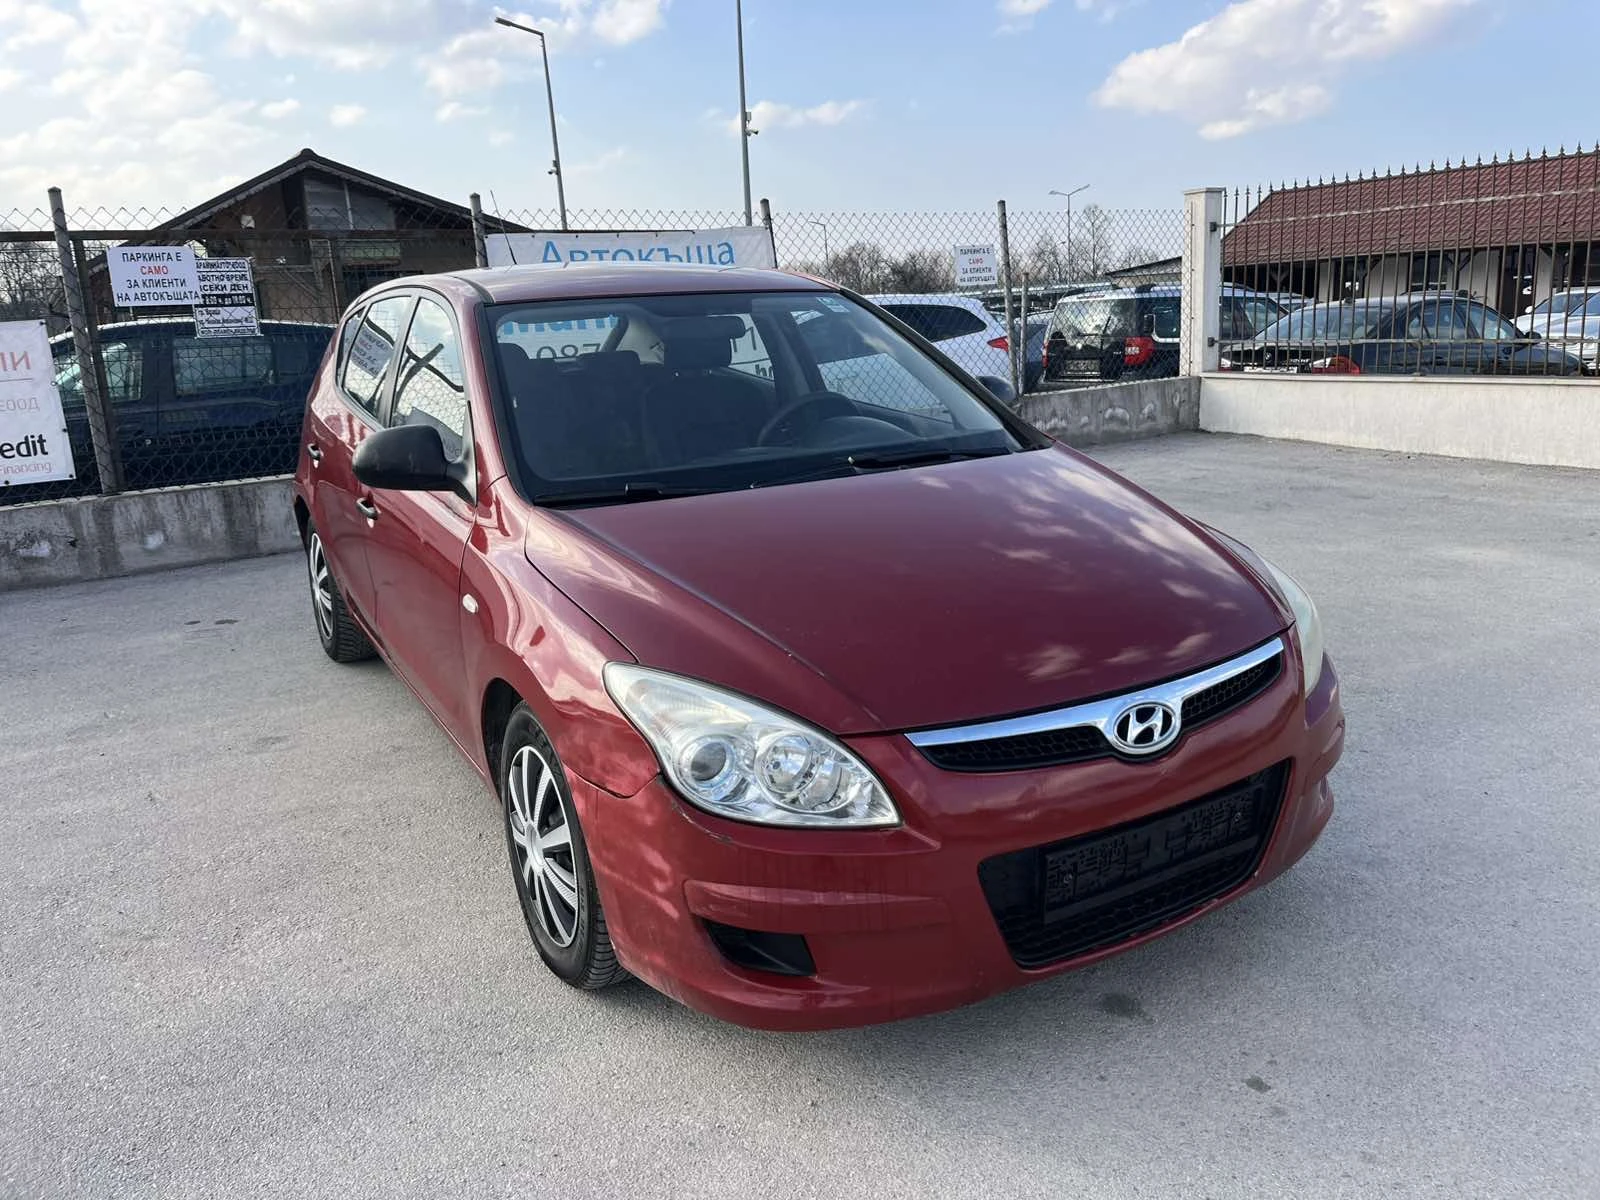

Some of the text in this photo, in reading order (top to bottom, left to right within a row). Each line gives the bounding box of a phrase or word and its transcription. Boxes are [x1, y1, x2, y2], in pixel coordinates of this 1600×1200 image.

[122, 252, 182, 262] ПАРКИНГА Е
[140, 265, 169, 275] САМО
[127, 278, 187, 289] ЗА КЛИЕНТИ
[230, 284, 249, 292] ДЕН
[117, 292, 131, 302] НА
[134, 291, 200, 302] АВТОКЪЩАТА
